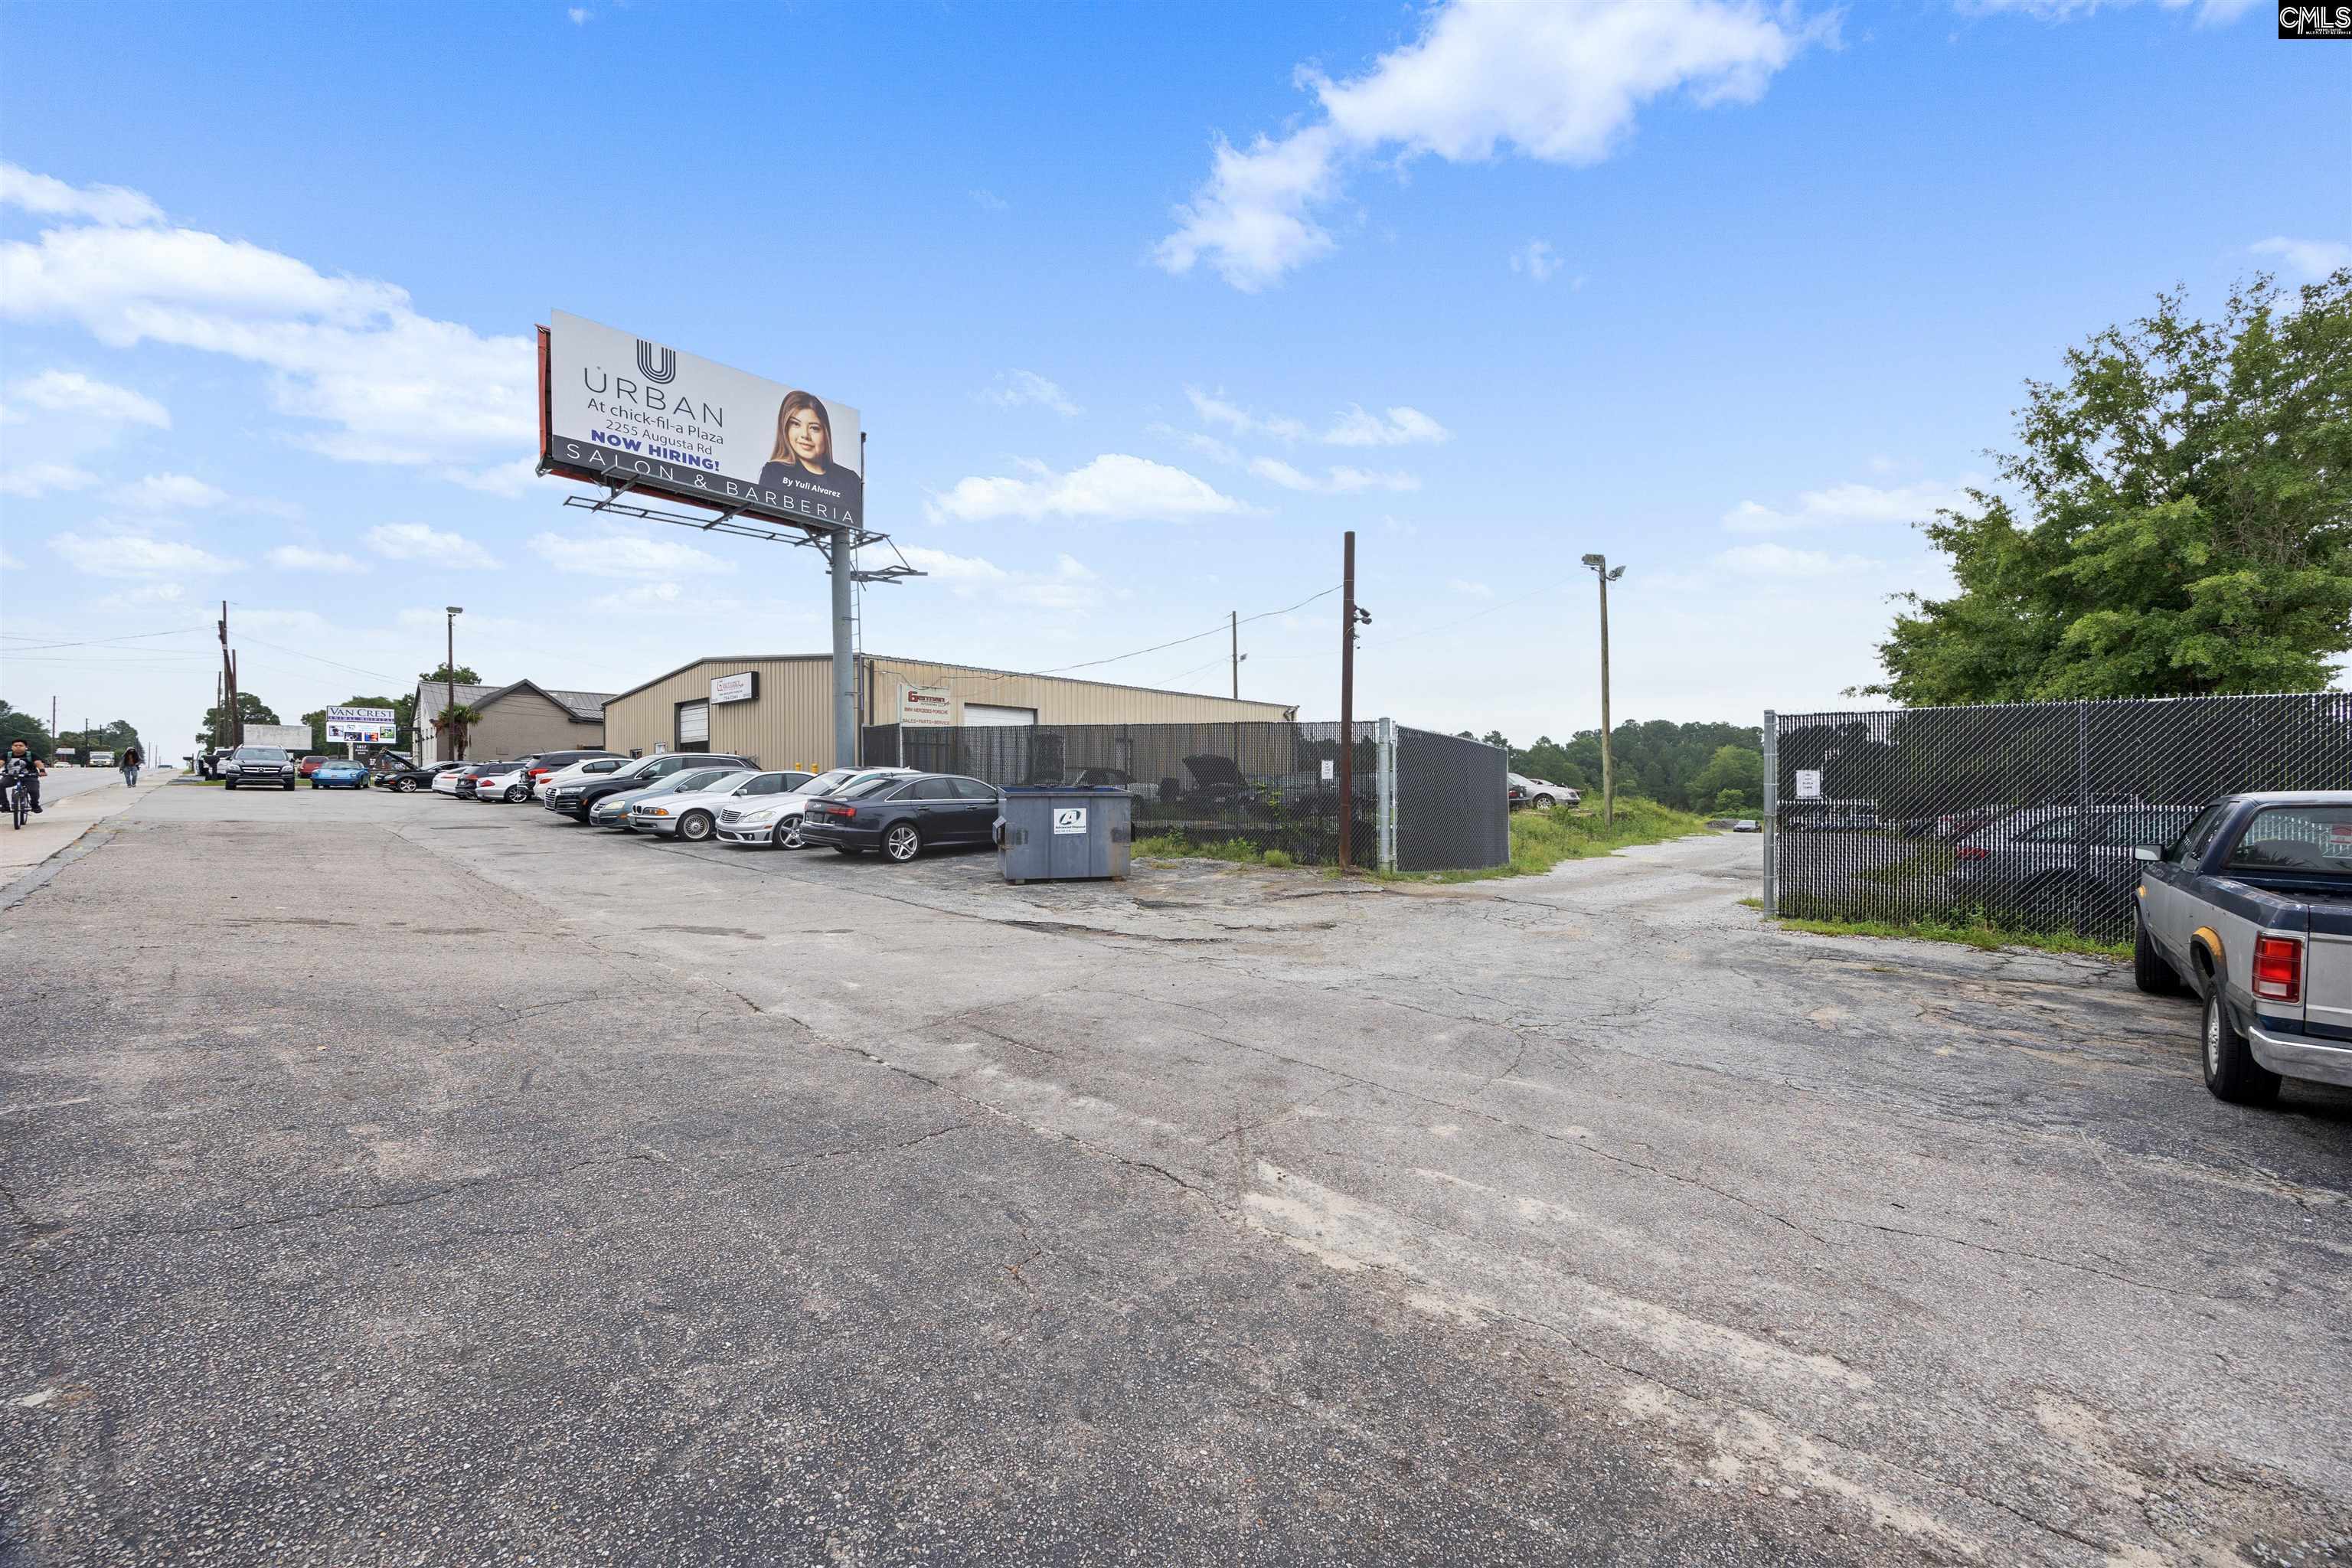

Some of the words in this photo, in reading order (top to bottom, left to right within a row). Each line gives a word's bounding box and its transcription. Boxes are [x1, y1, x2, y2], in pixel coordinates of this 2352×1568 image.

[584, 367, 723, 428] URBAN
[587, 398, 606, 413] At
[610, 405, 684, 434] chick-fil-a
[688, 425, 724, 445] Plaza
[606, 419, 638, 436] 2255
[642, 429, 694, 451] Augusta
[697, 443, 712, 456] Rd
[591, 429, 642, 452] NOW
[648, 443, 720, 472] HIRING!
[694, 474, 707, 488] &
[727, 481, 854, 524] BARBERIA
[782, 476, 793, 487] By
[795, 479, 811, 491] Yuli
[812, 485, 841, 498] Alvarez
[330, 707, 354, 717] VAN
[357, 708, 393, 718] CREST
